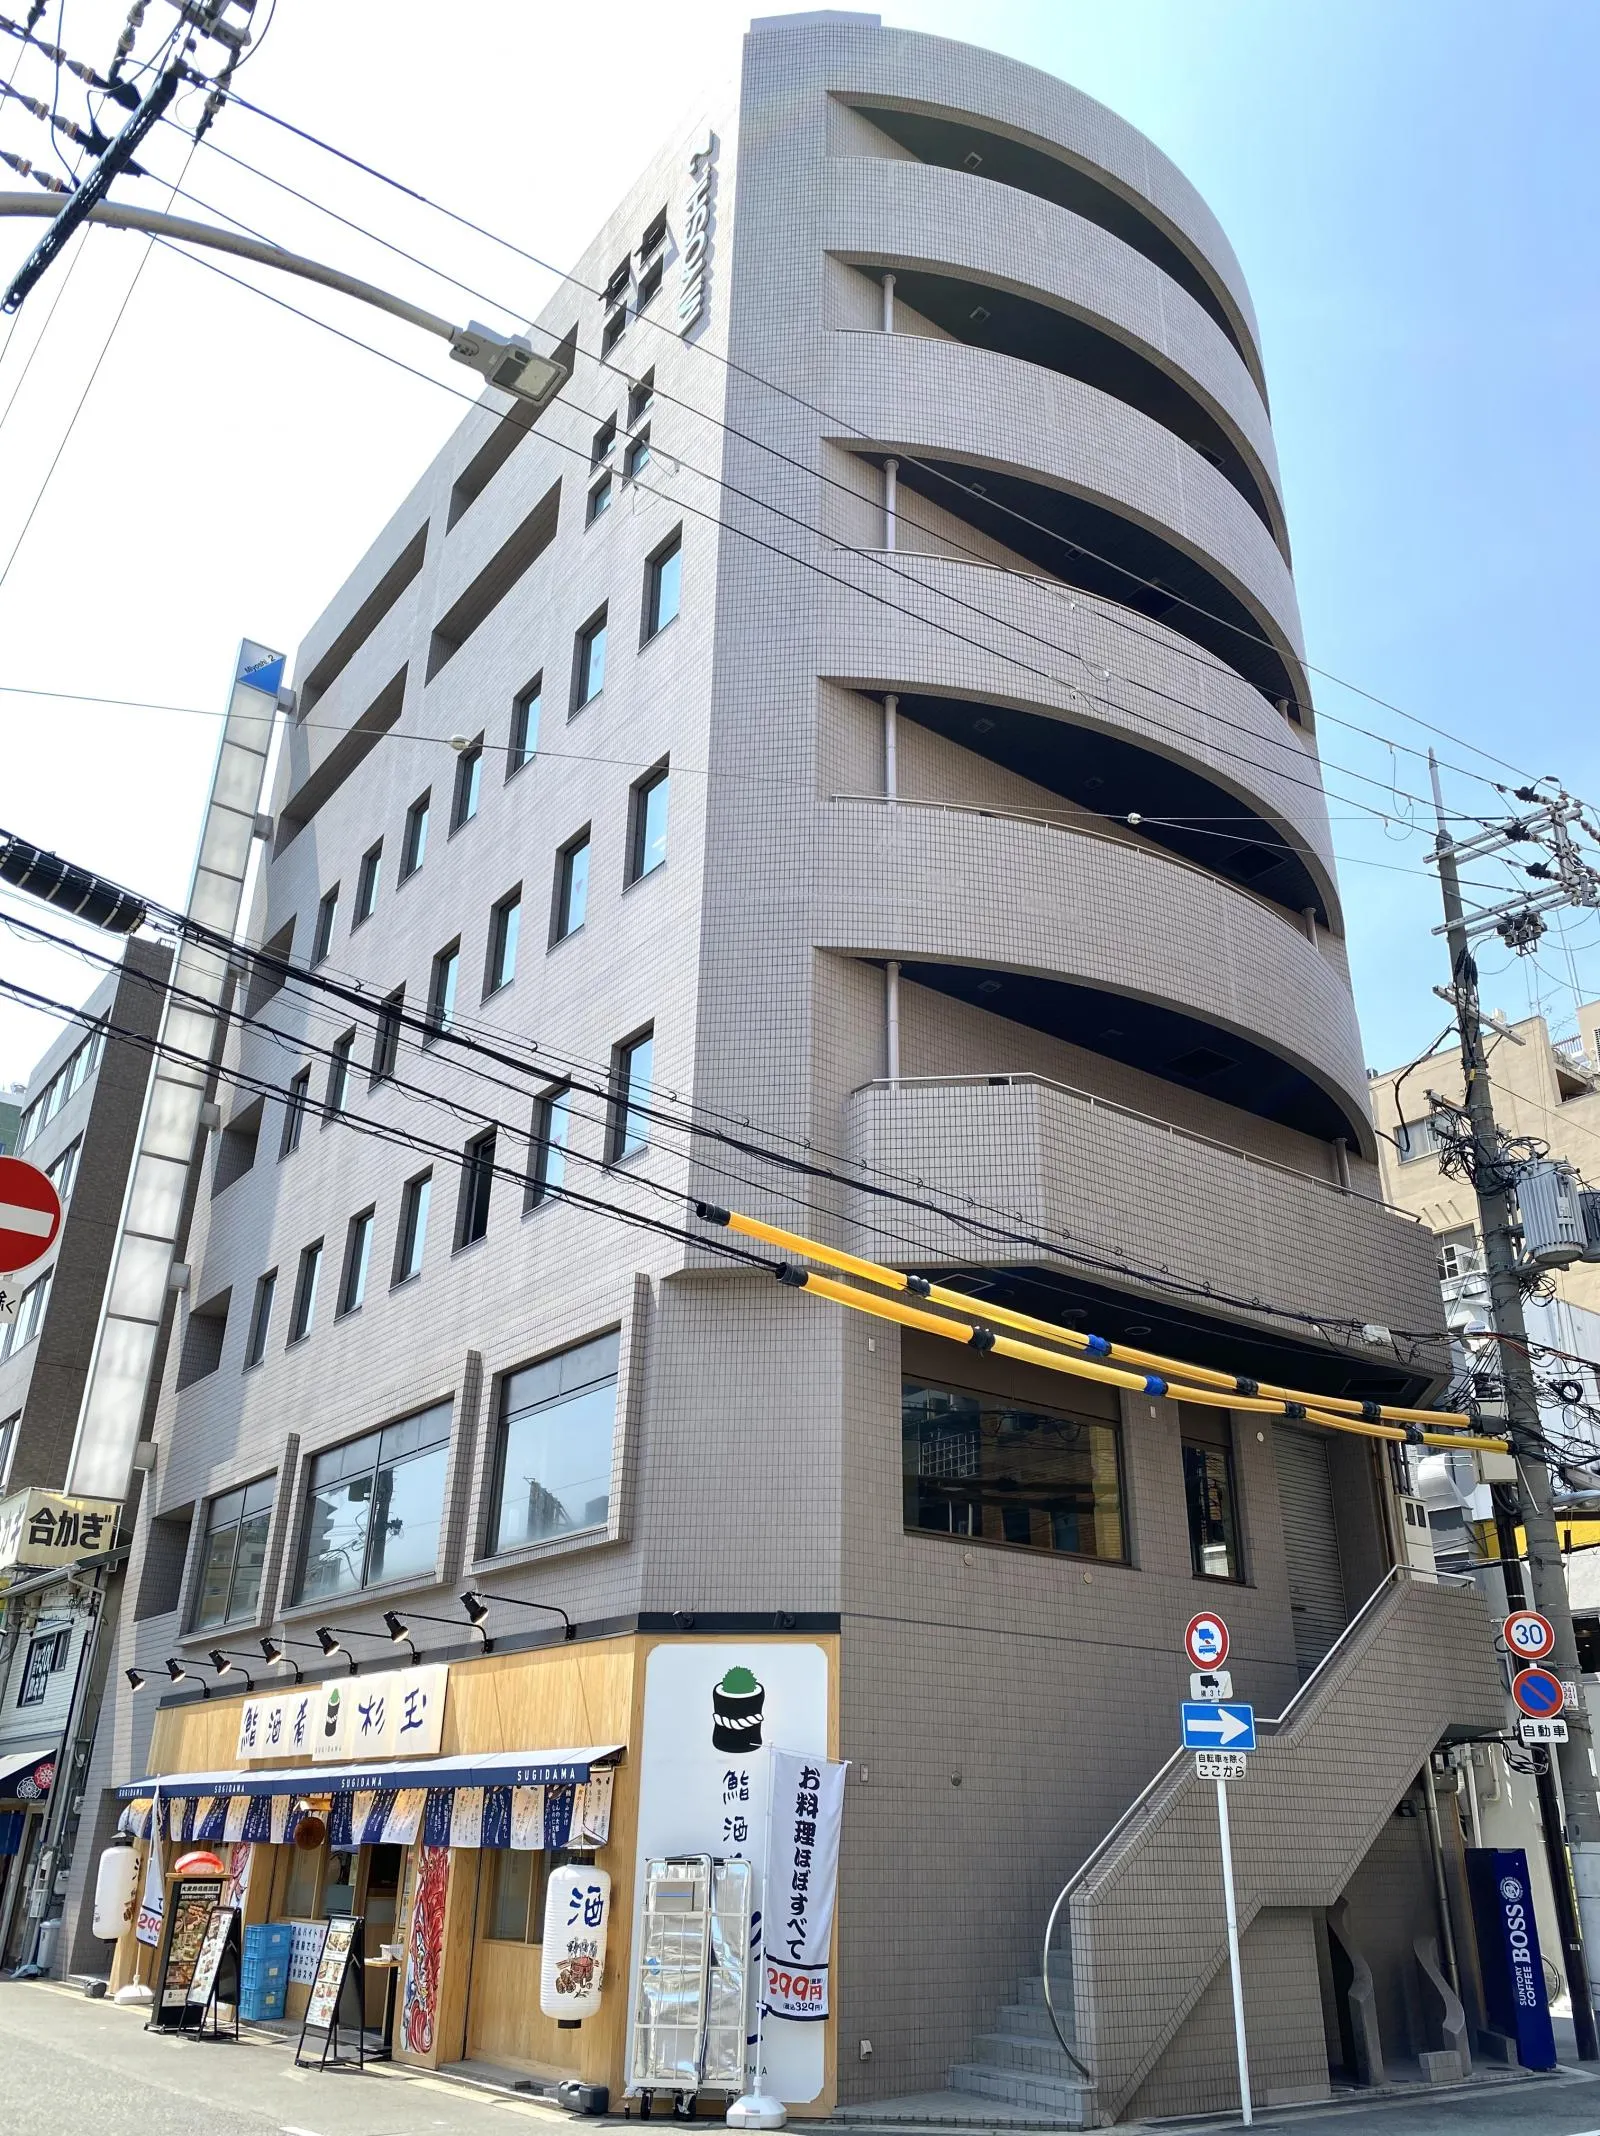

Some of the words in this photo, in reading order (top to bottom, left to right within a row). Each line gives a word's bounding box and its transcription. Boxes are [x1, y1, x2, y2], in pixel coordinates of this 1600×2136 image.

[28, 1507, 112, 1549] 合かぎ
[1515, 1624, 1543, 1646] 30
[358, 1687, 428, 1736] 杉玉
[1522, 1724, 1567, 1738] 自動車
[517, 1767, 576, 1782] SUGIDAMA
[1198, 1754, 1244, 1764] 自転車を除く
[1199, 1765, 1245, 1778] ここから
[118, 1788, 144, 1798] SUGIDAMA
[214, 1784, 245, 1793] SUGIDAMA
[341, 1776, 383, 1788] SUGIDAMA
[722, 1770, 750, 1858] 鮨酒
[786, 1765, 821, 1960] お料理ほぼすべて
[567, 1885, 604, 1928] 酒
[1505, 1904, 1531, 1964] BOSS
[1514, 1965, 1527, 2006] SUNTORY
[1523, 1966, 1537, 2007] COFFEE
